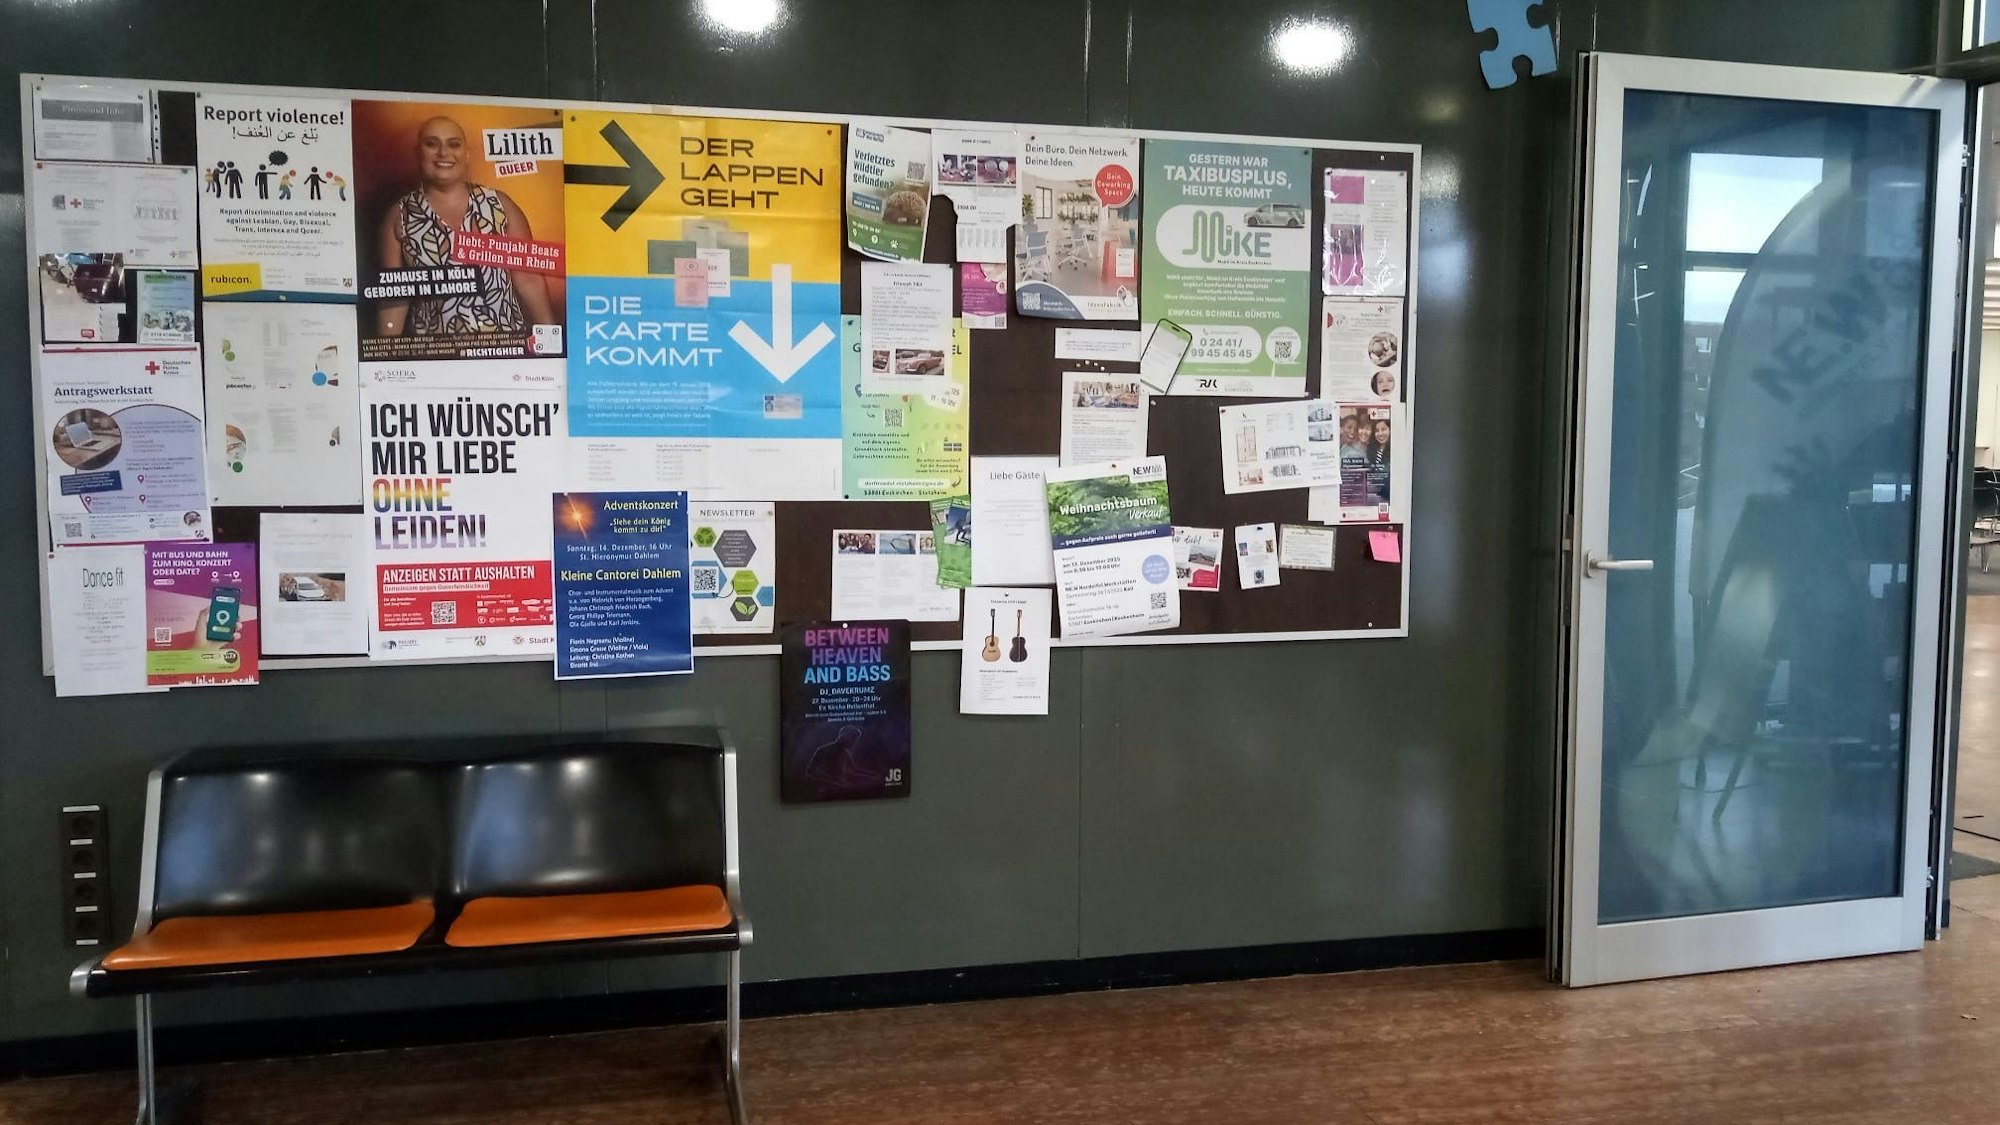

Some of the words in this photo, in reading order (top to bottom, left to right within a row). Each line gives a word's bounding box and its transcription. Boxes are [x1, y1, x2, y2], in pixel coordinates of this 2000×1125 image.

[204, 106, 262, 124] Report
[267, 108, 344, 125] violence!
[487, 131, 554, 156] Lilith
[681, 136, 754, 158] DER
[1026, 144, 1044, 153] Dein
[1069, 146, 1087, 154] Dein
[854, 149, 895, 167] Verletztes
[1026, 156, 1048, 166] Deine
[1190, 154, 1240, 166] GESTERN
[1243, 156, 1268, 168] WAR
[499, 161, 534, 176] QUEER
[681, 162, 823, 186] LAPPEN
[854, 160, 884, 176] Wildtier
[1164, 165, 1292, 188] TAXIBUSPLUS,
[854, 172, 894, 190] gefunden?
[681, 188, 779, 208] GEHT
[1182, 186, 1222, 197] HEUTE
[1226, 188, 1272, 199] KOMMT
[220, 208, 242, 216] Report
[458, 234, 485, 249] liebt:
[488, 238, 528, 254] Punjabi
[532, 244, 559, 258] Beats
[457, 249, 466, 260] &
[469, 250, 504, 264] Grillen
[507, 256, 523, 266] am
[526, 256, 556, 270] Rhein
[380, 270, 428, 284] ZUHAUSE
[432, 270, 445, 282] IN
[448, 266, 475, 280] KÖLN
[364, 285, 416, 298] GEBOREN
[418, 284, 431, 296] IN
[435, 282, 477, 294] LAHORE
[586, 296, 641, 315] DIE
[586, 321, 709, 342] KARTE
[460, 346, 524, 357] #RICHTIGHIER
[1200, 338, 1206, 347] 0
[1210, 338, 1222, 348] 24
[586, 348, 722, 366] KOMMT
[1191, 349, 1204, 358] 99
[1207, 349, 1221, 358] 45
[1222, 349, 1236, 358] 45
[1238, 349, 1252, 358] 45
[54, 386, 152, 398] Antragswerkstatt
[370, 404, 418, 438] ICH
[372, 442, 427, 475] MIR
[437, 440, 517, 474] LIEBE
[990, 472, 1013, 480] Liebe
[372, 478, 453, 513] OHNE
[604, 500, 678, 510] Adventskonzert
[1060, 496, 1157, 516] Weihnachtsbaum
[1130, 508, 1164, 520] Verkauf
[651, 518, 671, 526] König
[374, 514, 486, 550] LEIDEN!
[1082, 536, 1104, 544] Aufpreis
[83, 568, 113, 588] Dance
[116, 567, 124, 586] fit
[384, 568, 438, 584] ANZEIGEN
[440, 568, 472, 582] STATT
[474, 566, 534, 580] AUSHALTEN
[561, 571, 592, 580] Kleine
[596, 570, 639, 580] Cantorei
[644, 568, 681, 578] Dahlem
[805, 628, 888, 646] BETWEEN
[812, 648, 881, 664] HEAVEN
[804, 667, 840, 684] AND
[846, 665, 890, 682] BASS
[820, 686, 874, 696] DJ_DAVEKRUMZ
[886, 768, 901, 782] JG
